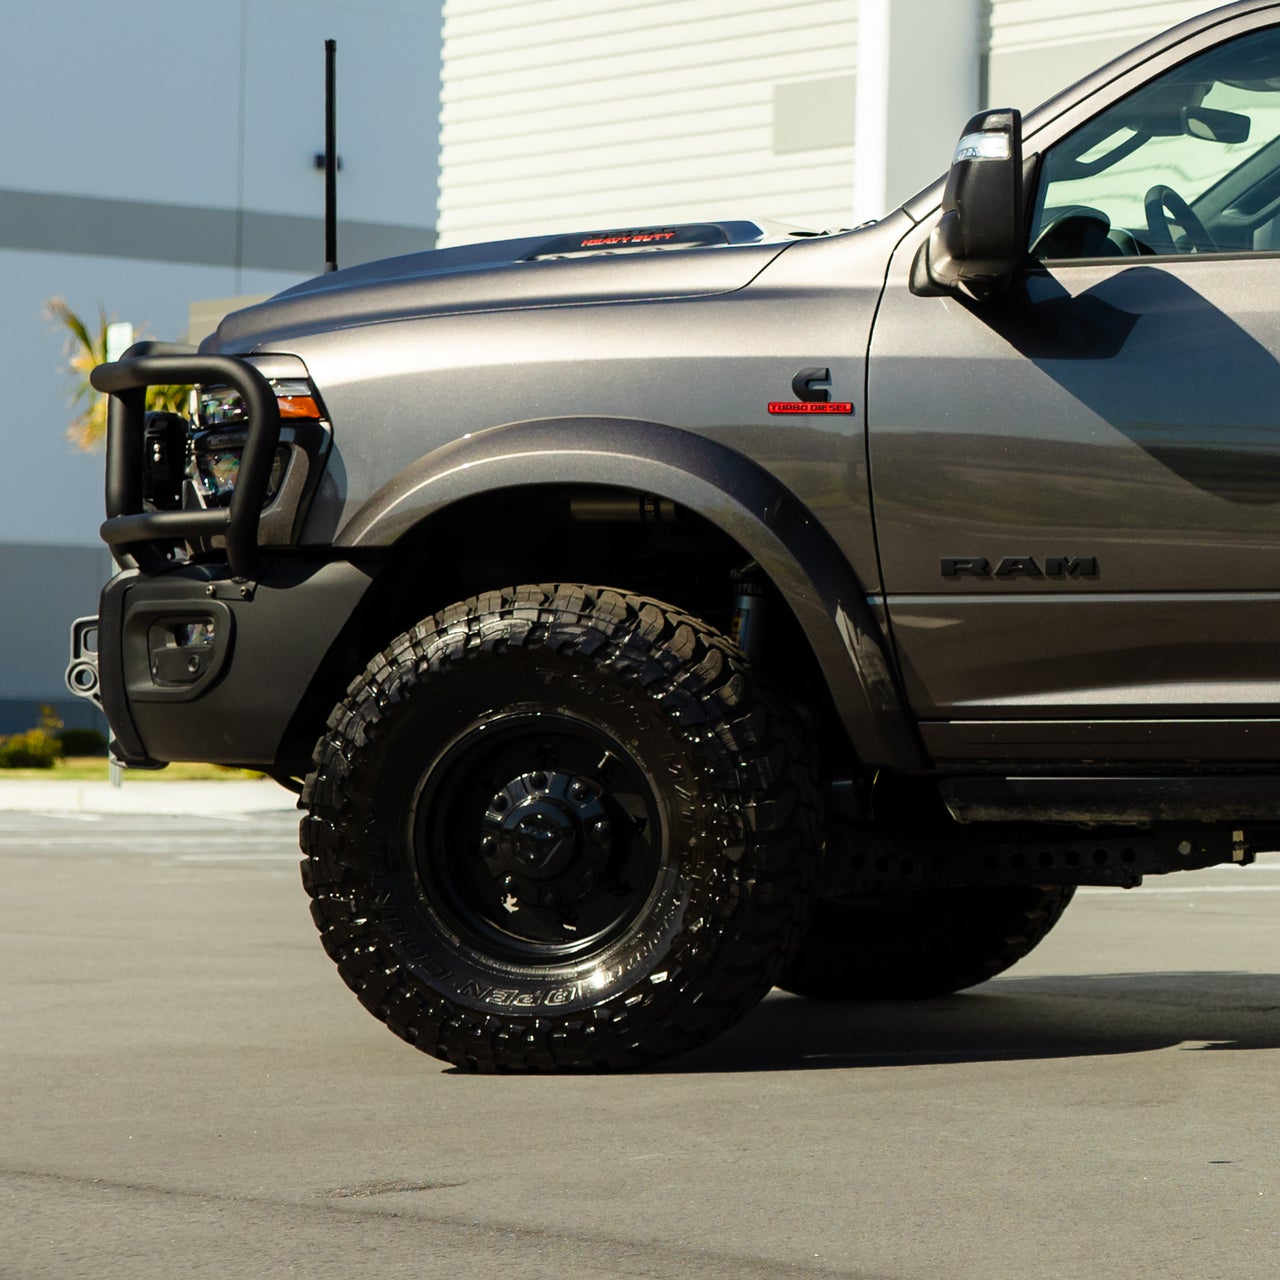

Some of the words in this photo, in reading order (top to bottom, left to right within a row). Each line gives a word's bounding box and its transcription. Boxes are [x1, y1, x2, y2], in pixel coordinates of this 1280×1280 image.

[580, 237, 632, 247] HEAVY
[632, 232, 675, 243] DUTY
[771, 404, 809, 412] TURBO
[810, 404, 850, 412] DIESEL
[940, 556, 1098, 578] RAM
